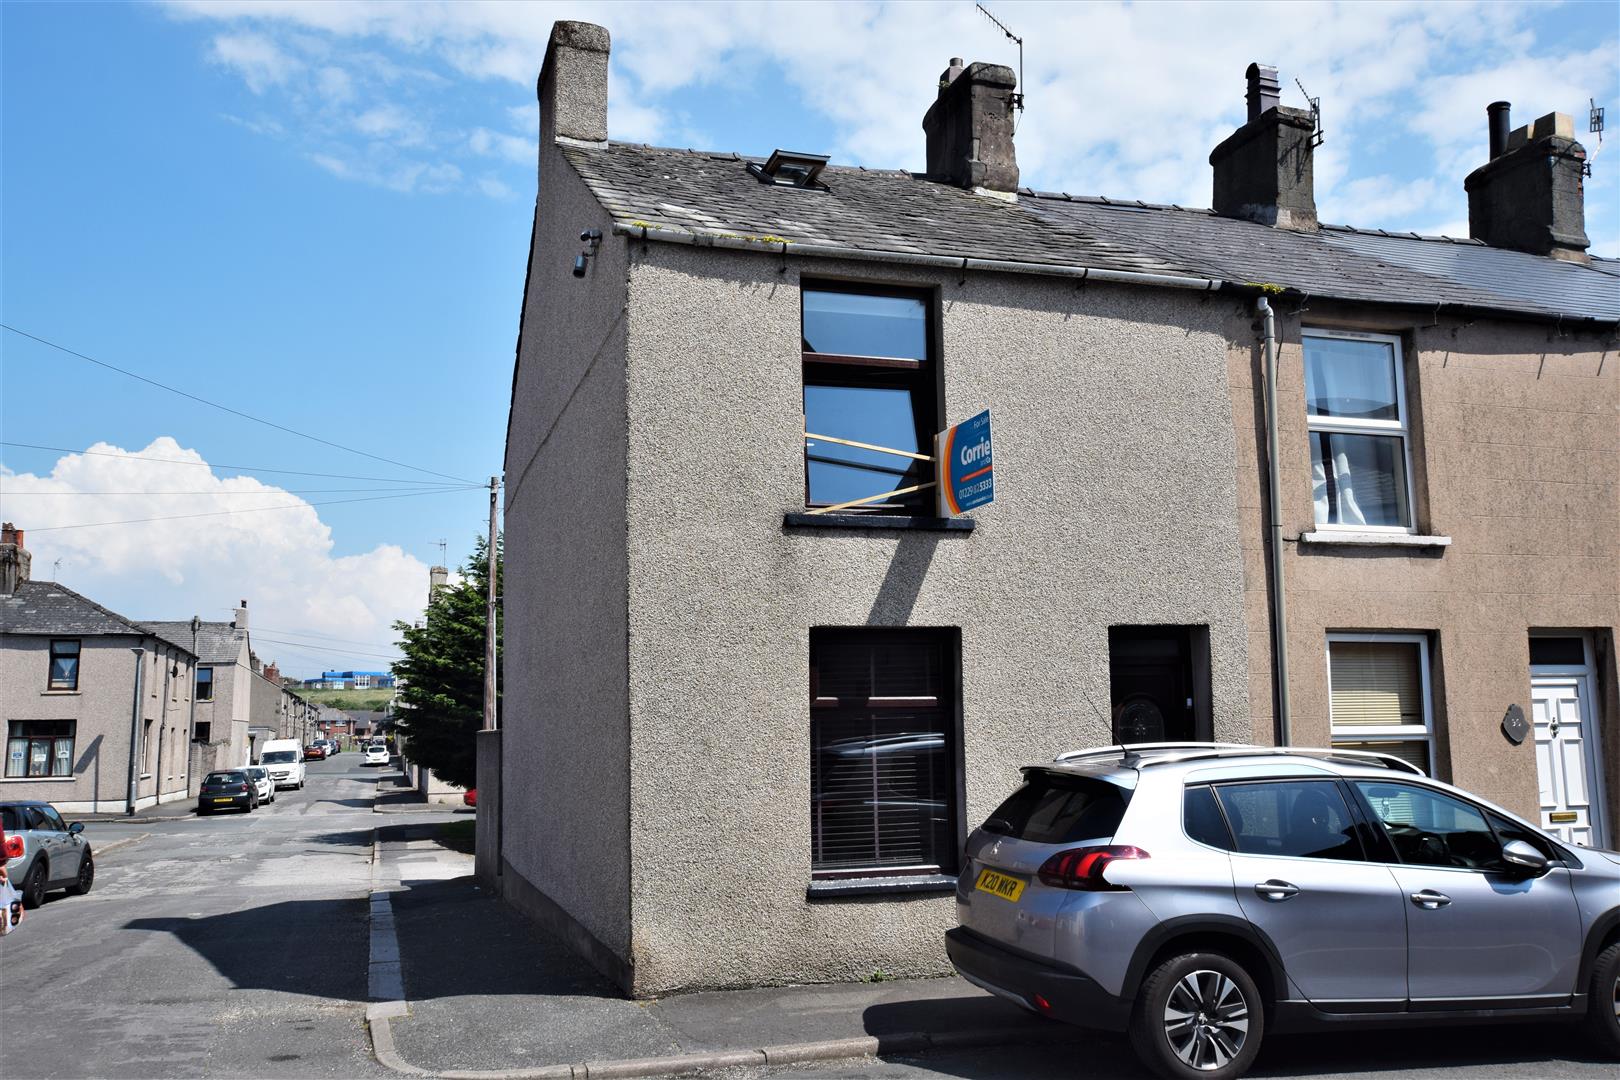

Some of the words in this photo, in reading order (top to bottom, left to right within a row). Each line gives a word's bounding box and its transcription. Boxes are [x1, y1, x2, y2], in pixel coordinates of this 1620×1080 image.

[981, 416, 989, 426] Sale
[961, 436, 991, 466] Corrie
[980, 871, 999, 890] K20
